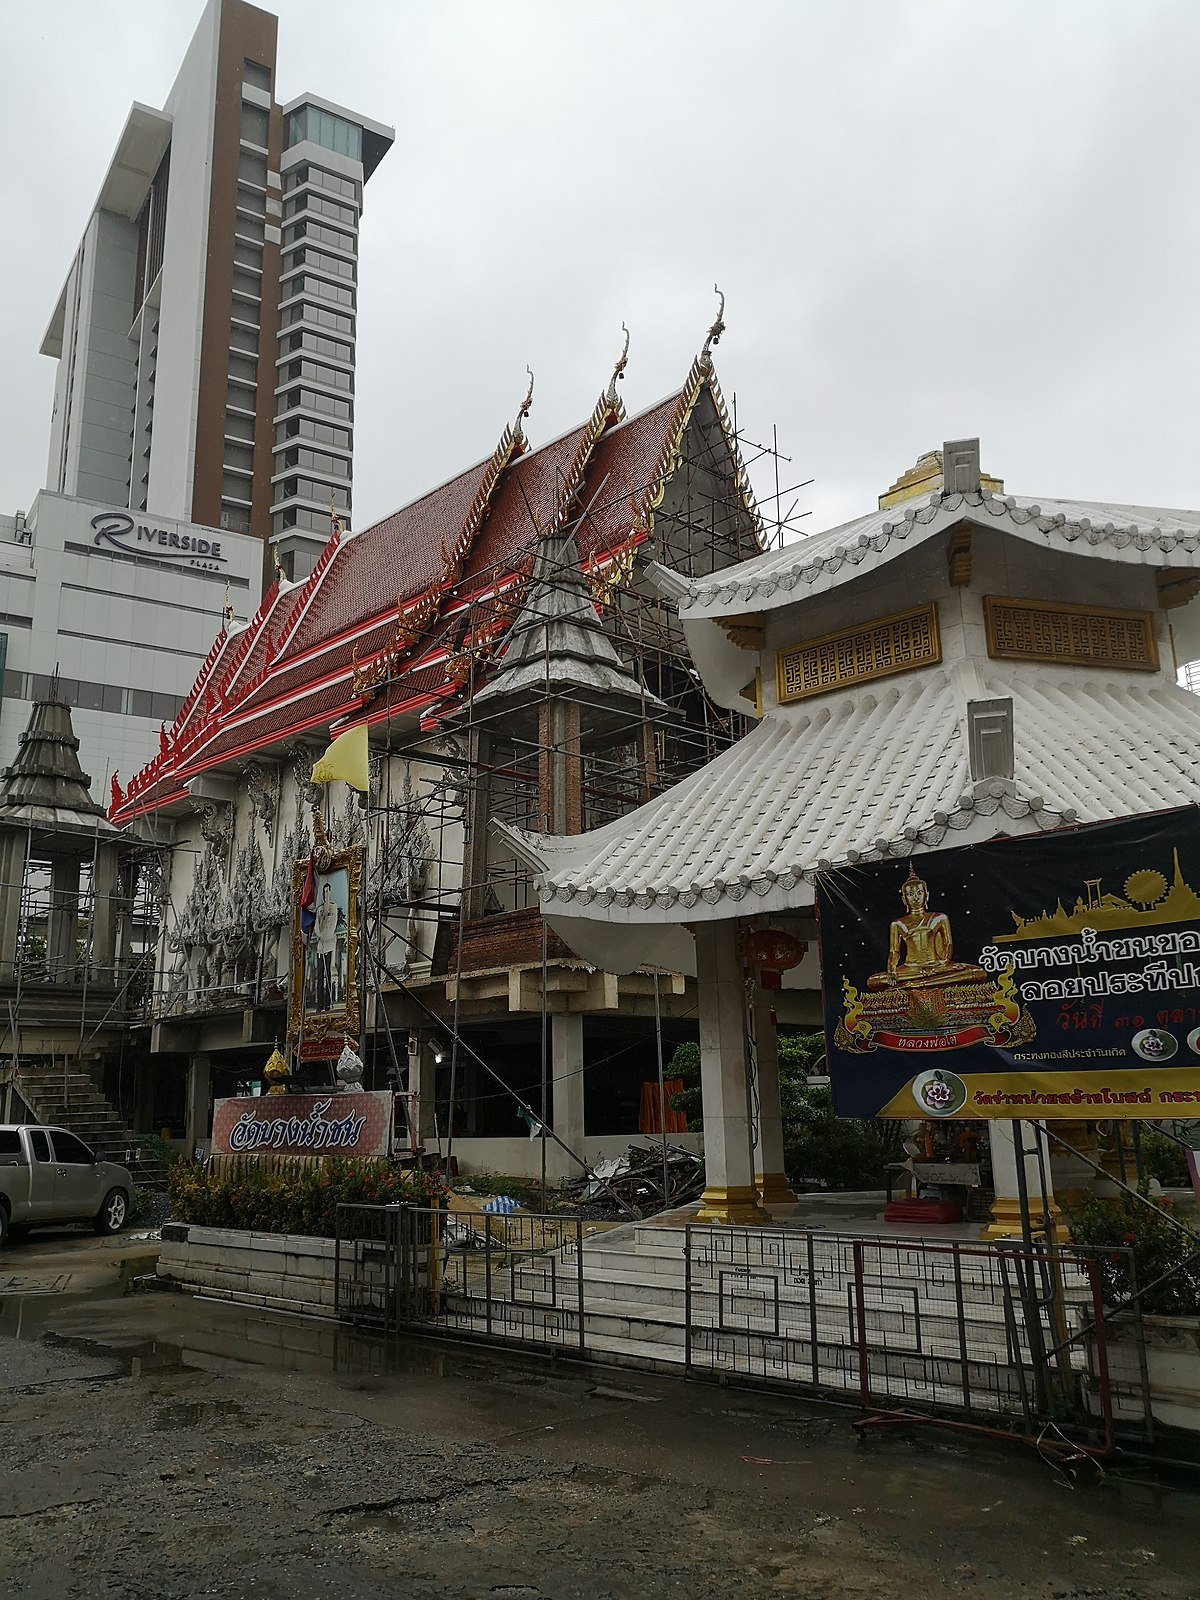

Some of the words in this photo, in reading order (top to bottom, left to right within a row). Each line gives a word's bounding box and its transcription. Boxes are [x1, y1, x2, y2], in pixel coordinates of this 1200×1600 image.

[90, 512, 222, 558] RIVERSIDE
[190, 559, 220, 571] PLAZA
[1056, 998, 1105, 1031] วันที่
[1156, 1007, 1200, 1031] ตุลา
[229, 1098, 367, 1152] วัดบางน้ำชน
